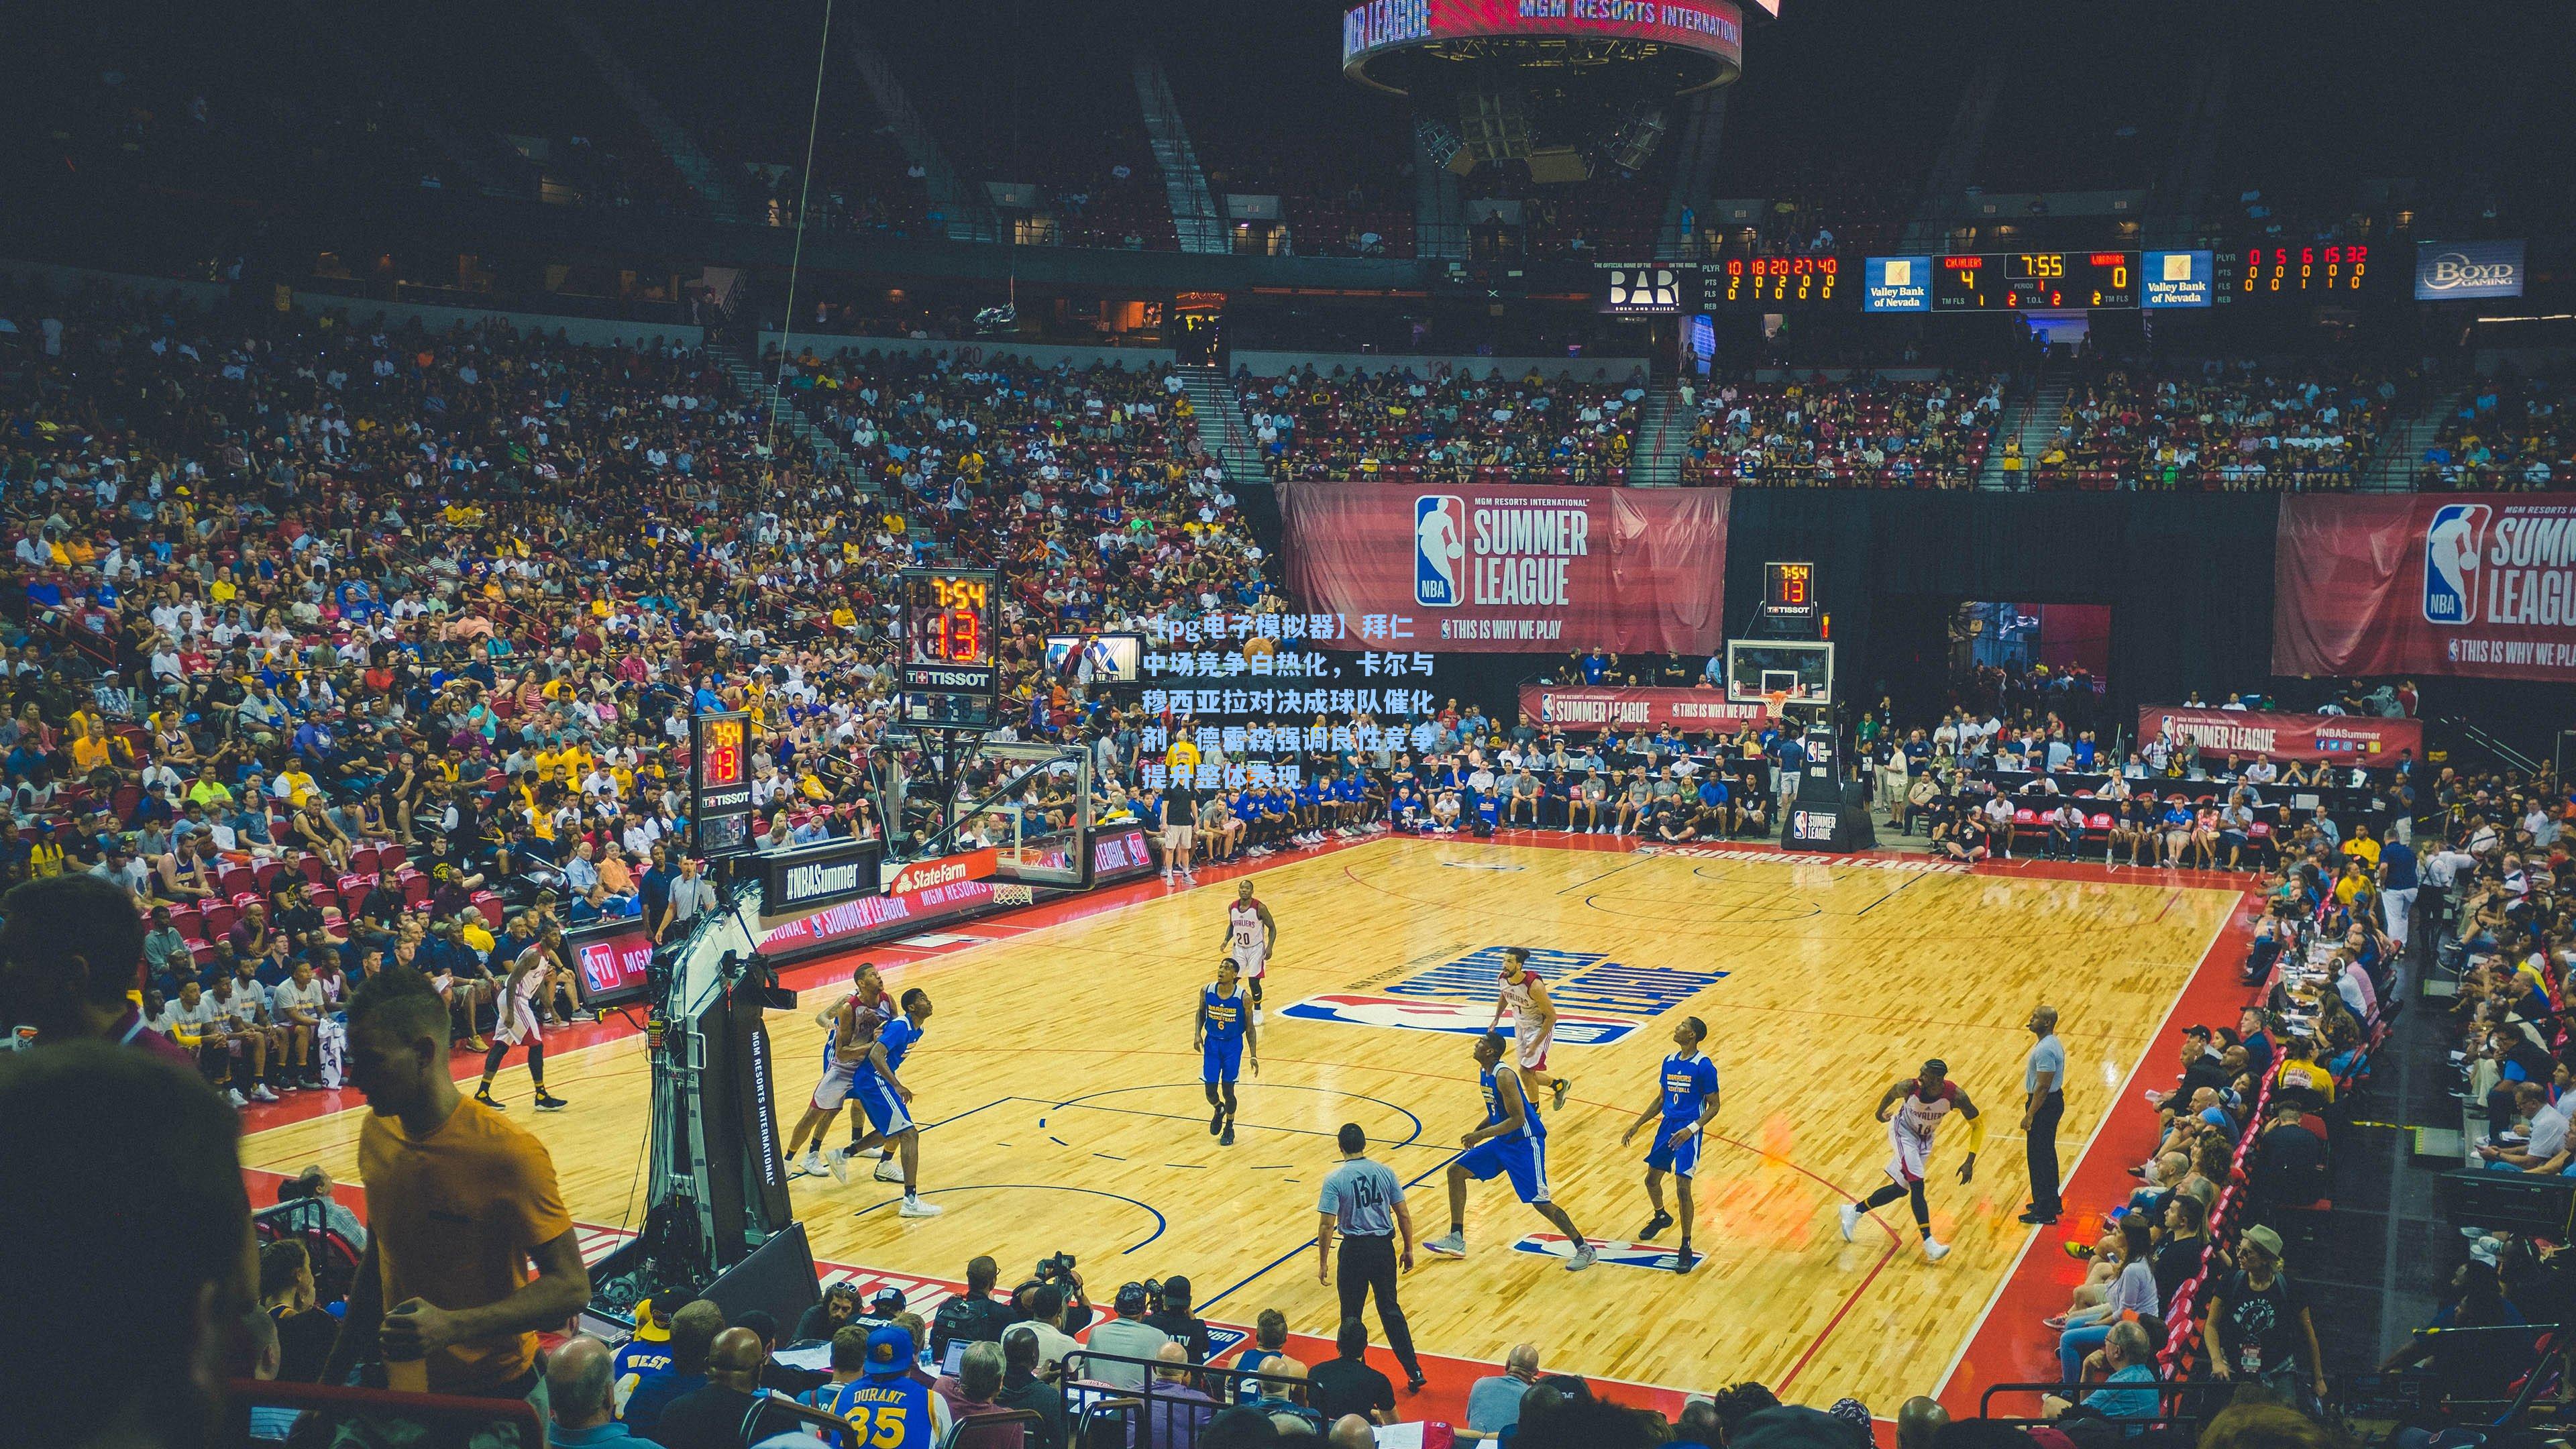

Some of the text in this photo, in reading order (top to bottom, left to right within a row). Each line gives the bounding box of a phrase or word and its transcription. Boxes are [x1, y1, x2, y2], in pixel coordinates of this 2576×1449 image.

[1572, 0, 1655, 23] RESORTS
[2216, 246, 2367, 265] PLYR 0 5 6 15 32
[1702, 259, 1837, 275] PLYR 10 18 20 27 40
[2021, 255, 2063, 277] 7:55
[2218, 263, 2364, 278] PTS 0 0 0 0 0
[2435, 262, 2512, 281] BOYD
[1732, 276, 1739, 288] 2
[1756, 275, 1763, 288] 0
[1779, 275, 1786, 288] 2
[1803, 274, 1810, 287] 0
[1827, 274, 1834, 286] 0
[1962, 270, 1974, 290] 4
[2039, 279, 2045, 291] 1
[2114, 266, 2127, 288] 0
[2245, 279, 2253, 291] 0
[2271, 278, 2279, 290] 0
[2351, 276, 2359, 288] 0
[2461, 276, 2512, 286] GAMING
[1728, 288, 1735, 300] 0
[1755, 287, 1760, 299] 1
[1775, 288, 1782, 299] 0
[1799, 287, 1806, 299] 0
[1822, 286, 1830, 299] 0
[1871, 286, 1925, 298] Valley Bank
[2148, 281, 2206, 292] Valley Bank
[1874, 298, 1920, 307] of Nevada
[1980, 294, 1984, 306] 1
[2008, 292, 2017, 307] 2
[2053, 291, 2061, 305] 2
[2092, 290, 2101, 305] 2
[2151, 293, 2201, 303] of Nevada
[1474, 497, 1589, 506] MGM RESORTS INTERNATIONAL
[2505, 506, 2526, 514] MGM
[2528, 506, 2567, 514] RESORTS
[1474, 509, 1588, 556] SUMMER
[1781, 565, 1809, 580] 7:54
[1421, 580, 1445, 598] NBA
[1474, 557, 1569, 606] LEAGUE
[932, 579, 985, 610] 7:54
[1783, 580, 1803, 602] 13
[2430, 594, 2455, 614] NBA
[938, 612, 979, 661] 13
[1452, 619, 1562, 640] THIS IS WHY WE PLAY
[2461, 639, 2554, 665] THIS IS WHY WE
[928, 672, 989, 687] TISSOT
[1556, 700, 1650, 723] SUMMER LEAGUE
[1680, 703, 1758, 719] THIS IS WHY WE PLAY
[2231, 727, 2276, 752] LEAGUE
[2316, 728, 2381, 740] #NBASummer
[717, 749, 736, 780] 13
[1810, 766, 1827, 778] @NBA
[716, 791, 750, 806] TISSOT
[1809, 815, 1836, 828] SUMMER
[1808, 826, 1831, 841] LEAGUE
[1099, 839, 1128, 872] LEAGUE
[1134, 838, 1146, 859] TV
[1673, 847, 1974, 874] SUMMER LEAGUE
[787, 863, 859, 900] #NBASummer
[912, 863, 966, 890] StateFarm
[824, 881, 987, 934] SUMMER LEAGUE MGM RESORTS
[1236, 932, 1250, 945] 20
[594, 950, 653, 981] TV MGM
[1551, 962, 1732, 1016] LEAGUE
[1208, 1004, 1236, 1014] WARRIORS
[1218, 1021, 1225, 1030] 6
[1673, 1093, 1679, 1105] 0
[751, 1030, 775, 1186] MGM RESORTS INTERNATIONAL
[1351, 1174, 1384, 1208] 134
[1177, 1335, 1191, 1347] TV
[627, 1354, 672, 1370] WEST
[853, 1387, 908, 1405] DURANT
[844, 1406, 908, 1449] 35
